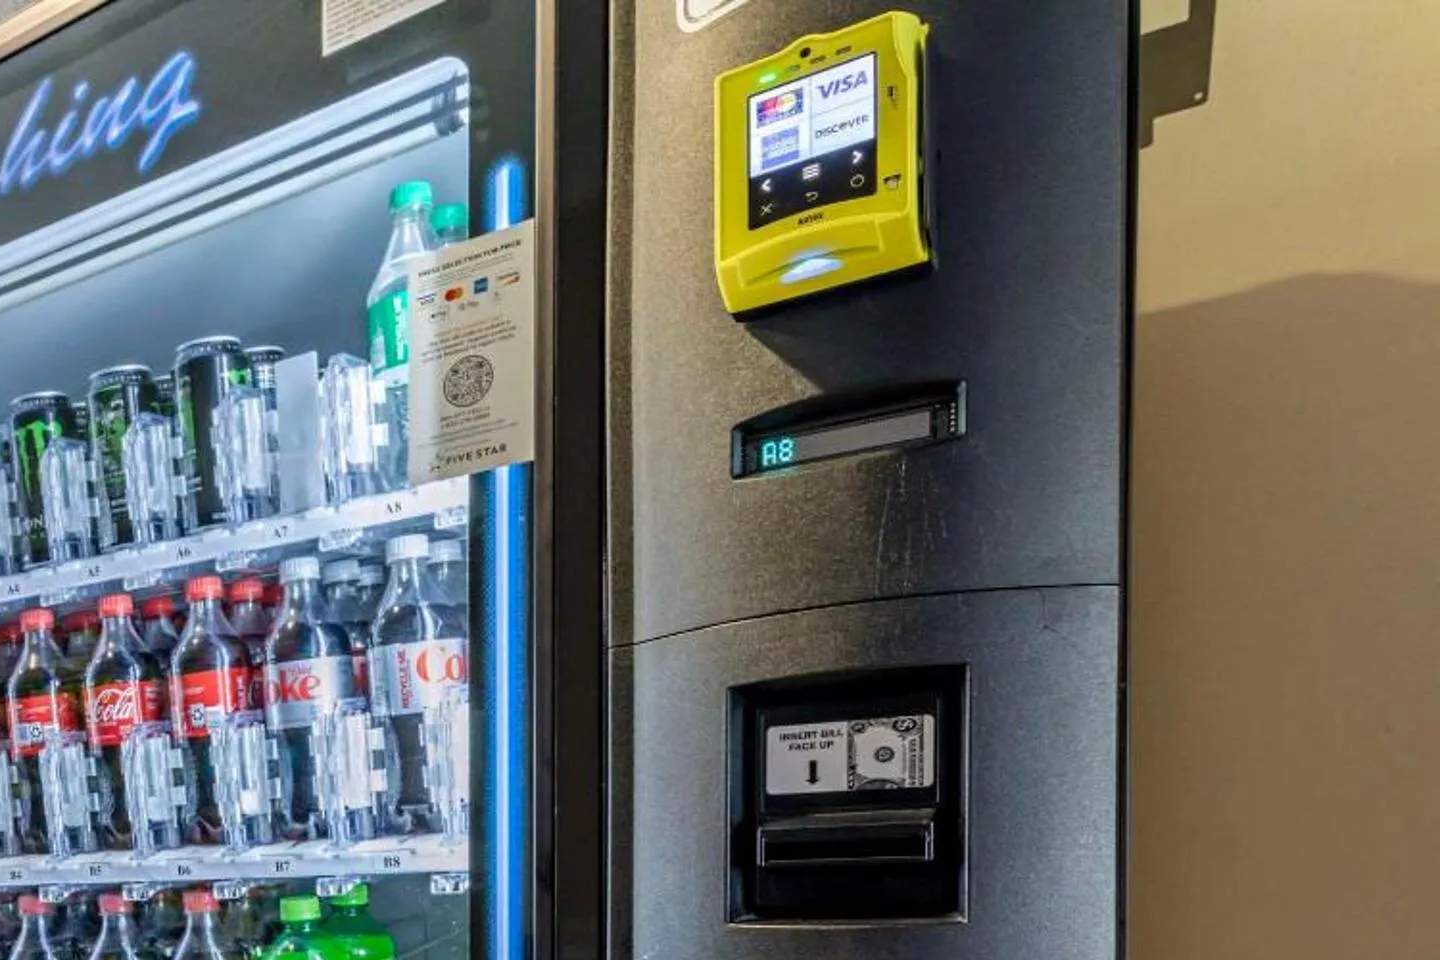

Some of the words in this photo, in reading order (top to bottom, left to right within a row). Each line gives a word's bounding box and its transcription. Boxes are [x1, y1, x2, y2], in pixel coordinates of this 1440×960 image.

[817, 70, 868, 100] VISA
[815, 114, 870, 139] DISCOVER
[446, 451, 473, 465] FIVE
[475, 443, 507, 460] STAR
[762, 438, 794, 466] A8
[384, 502, 402, 515] A8
[273, 525, 289, 540] A7
[779, 731, 818, 742] INSERT
[788, 742, 815, 752] FACE
[819, 740, 835, 750] UP
[275, 861, 291, 873] B7
[383, 856, 401, 869] B8
